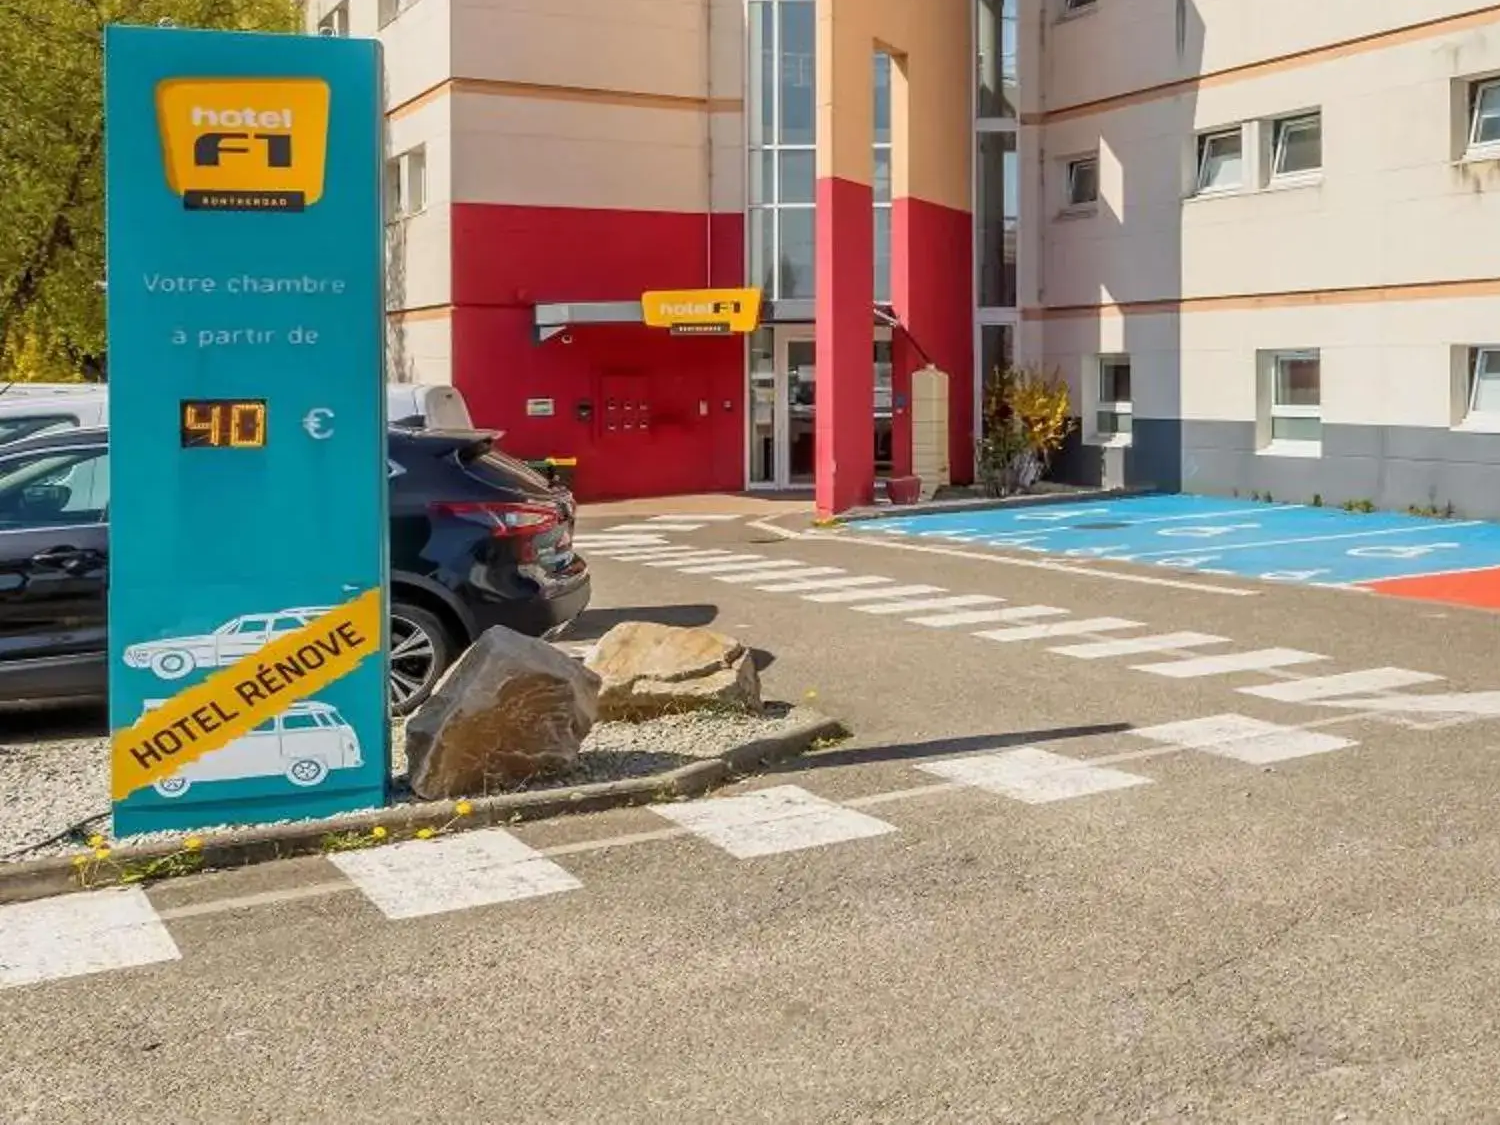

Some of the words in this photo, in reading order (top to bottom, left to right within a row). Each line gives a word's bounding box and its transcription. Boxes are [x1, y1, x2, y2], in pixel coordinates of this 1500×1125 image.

[191, 106, 292, 128] hotel
[194, 132, 292, 168] F1
[143, 273, 216, 293] Votre
[227, 275, 346, 294] chambre
[199, 327, 275, 348] partir
[288, 325, 319, 344] de
[184, 404, 264, 447] 40
[303, 408, 335, 440] €
[129, 700, 240, 770] HOTEL
[233, 620, 366, 708] RÉNOVE
